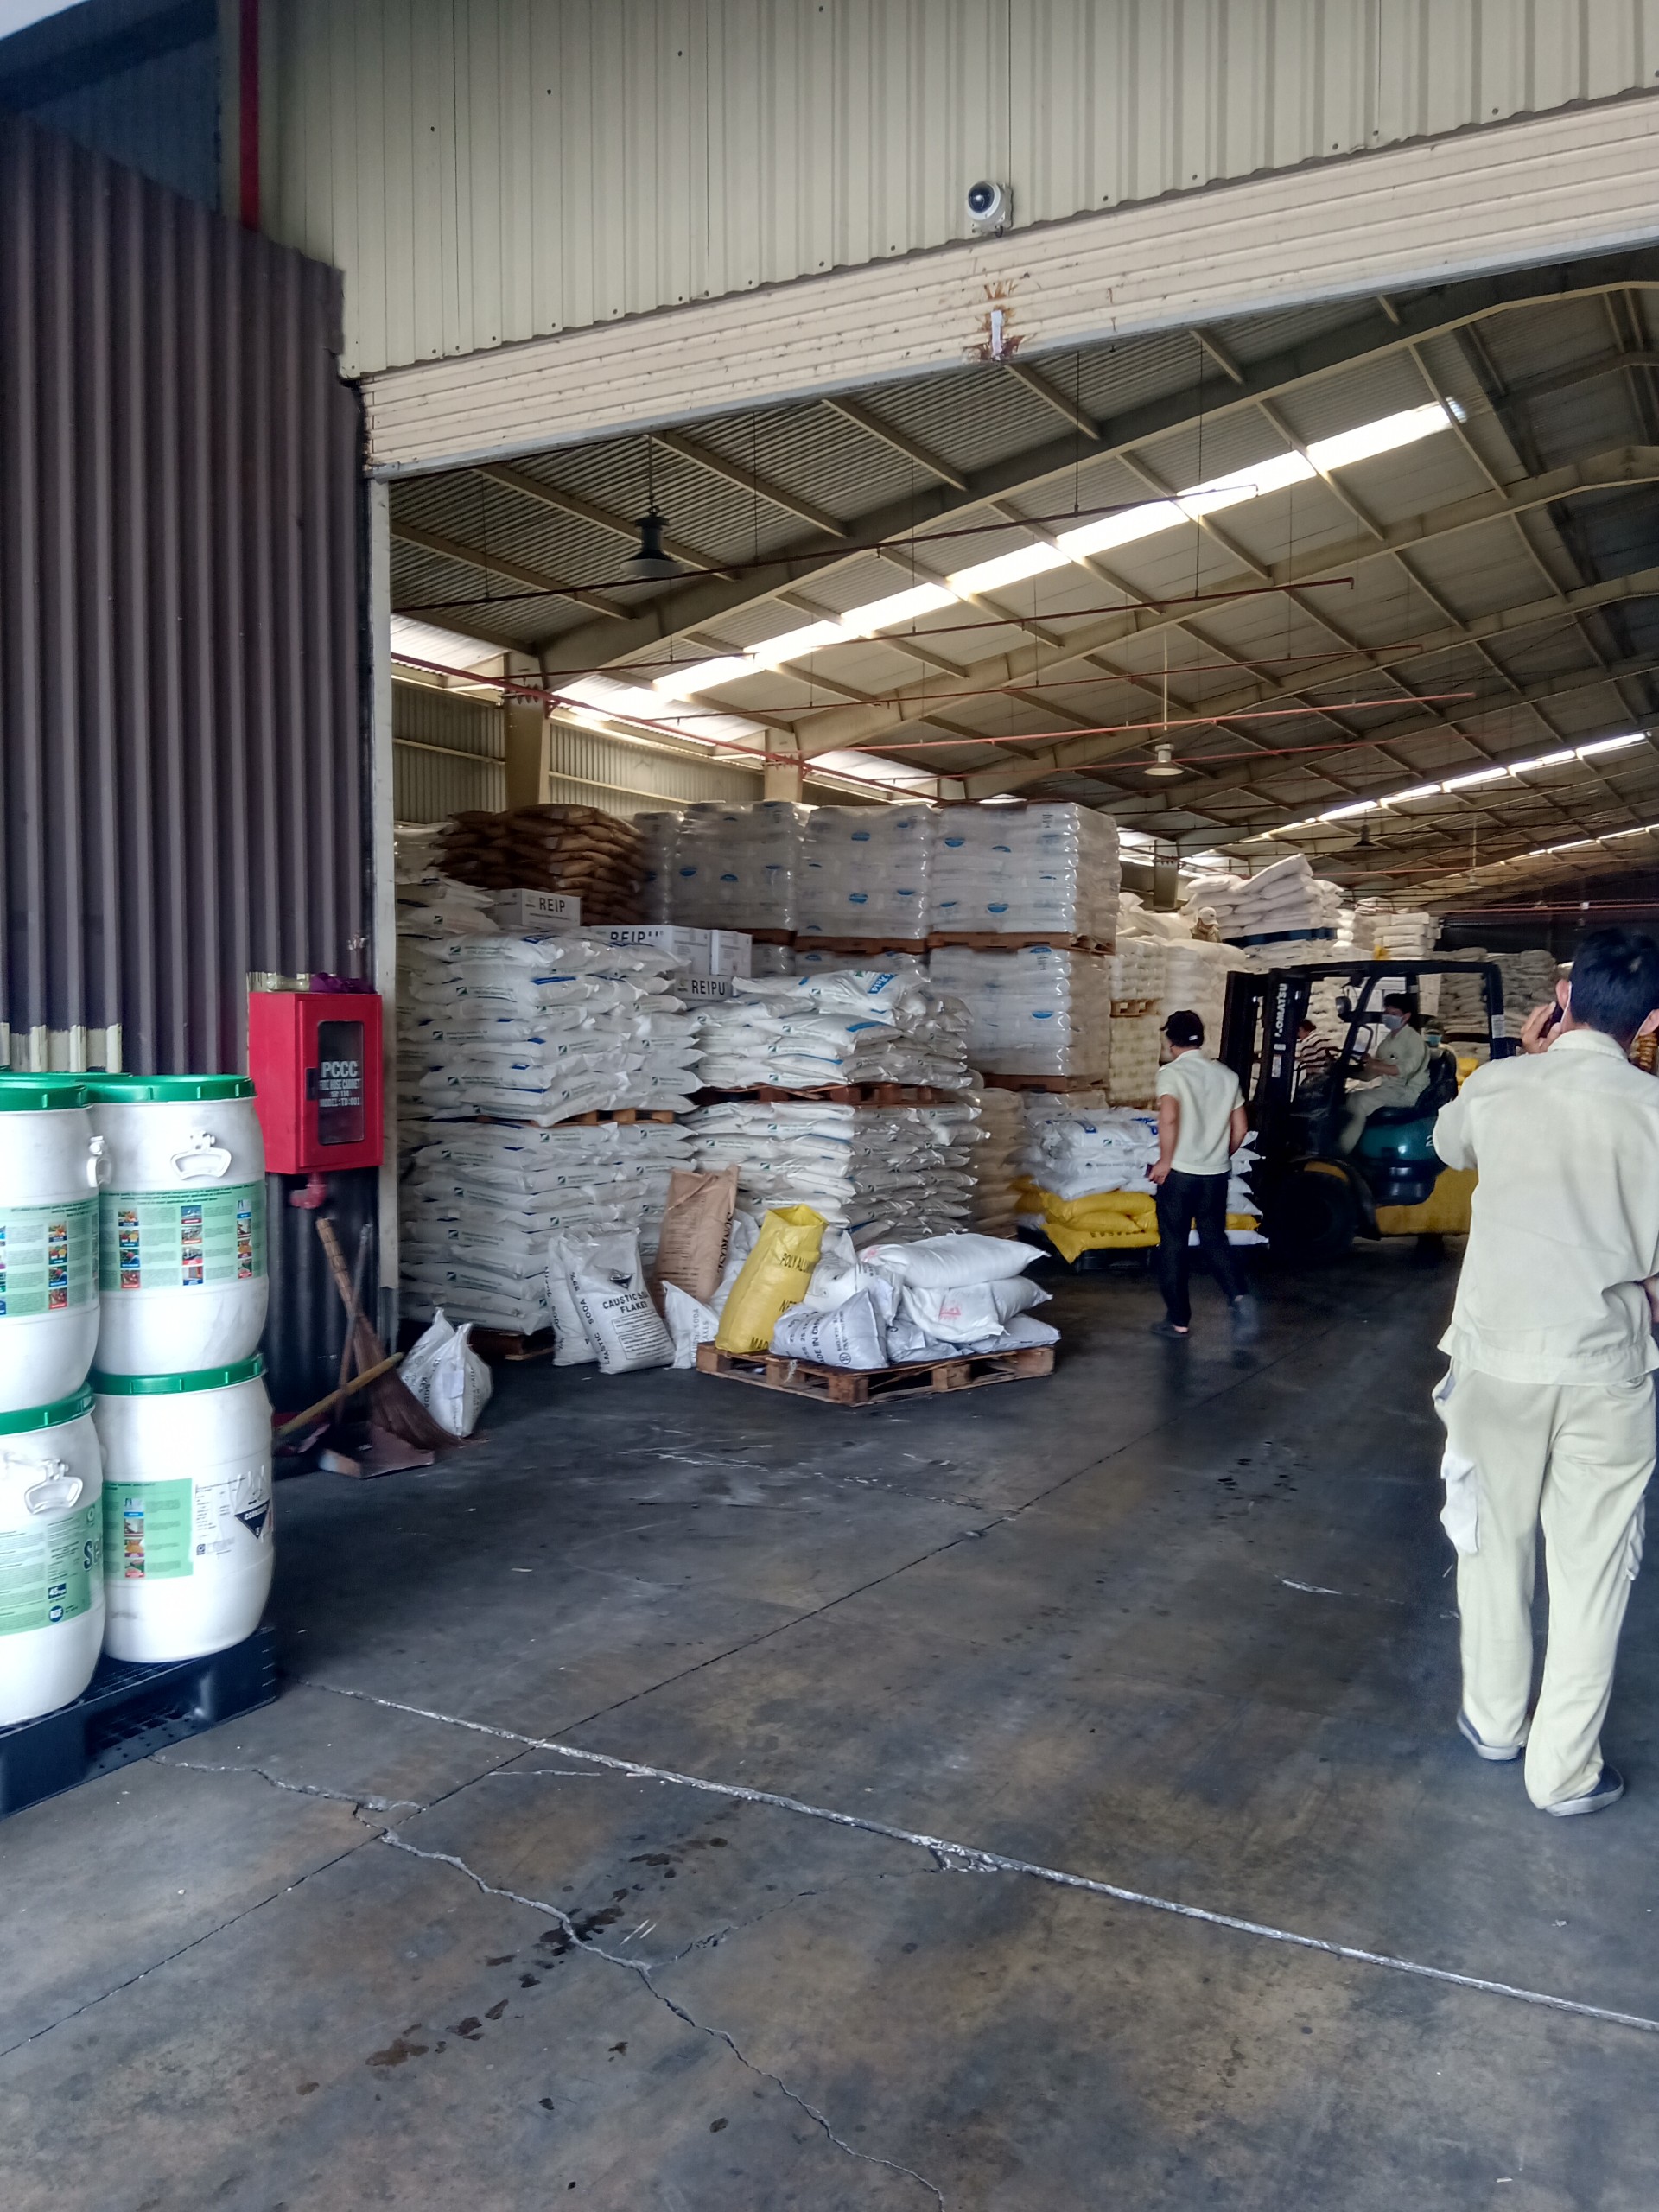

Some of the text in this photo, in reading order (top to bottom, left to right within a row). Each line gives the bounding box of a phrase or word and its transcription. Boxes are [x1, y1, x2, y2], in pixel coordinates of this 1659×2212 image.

[691, 979, 726, 995] REIPU
[321, 1060, 358, 1078] PCCC
[603, 1292, 638, 1310] CAUSTIC
[620, 1300, 648, 1314] FLAKES
[580, 1298, 594, 1325] SODA
[749, 1337, 769, 1351] MAD
[814, 1350, 825, 1363] ADE
